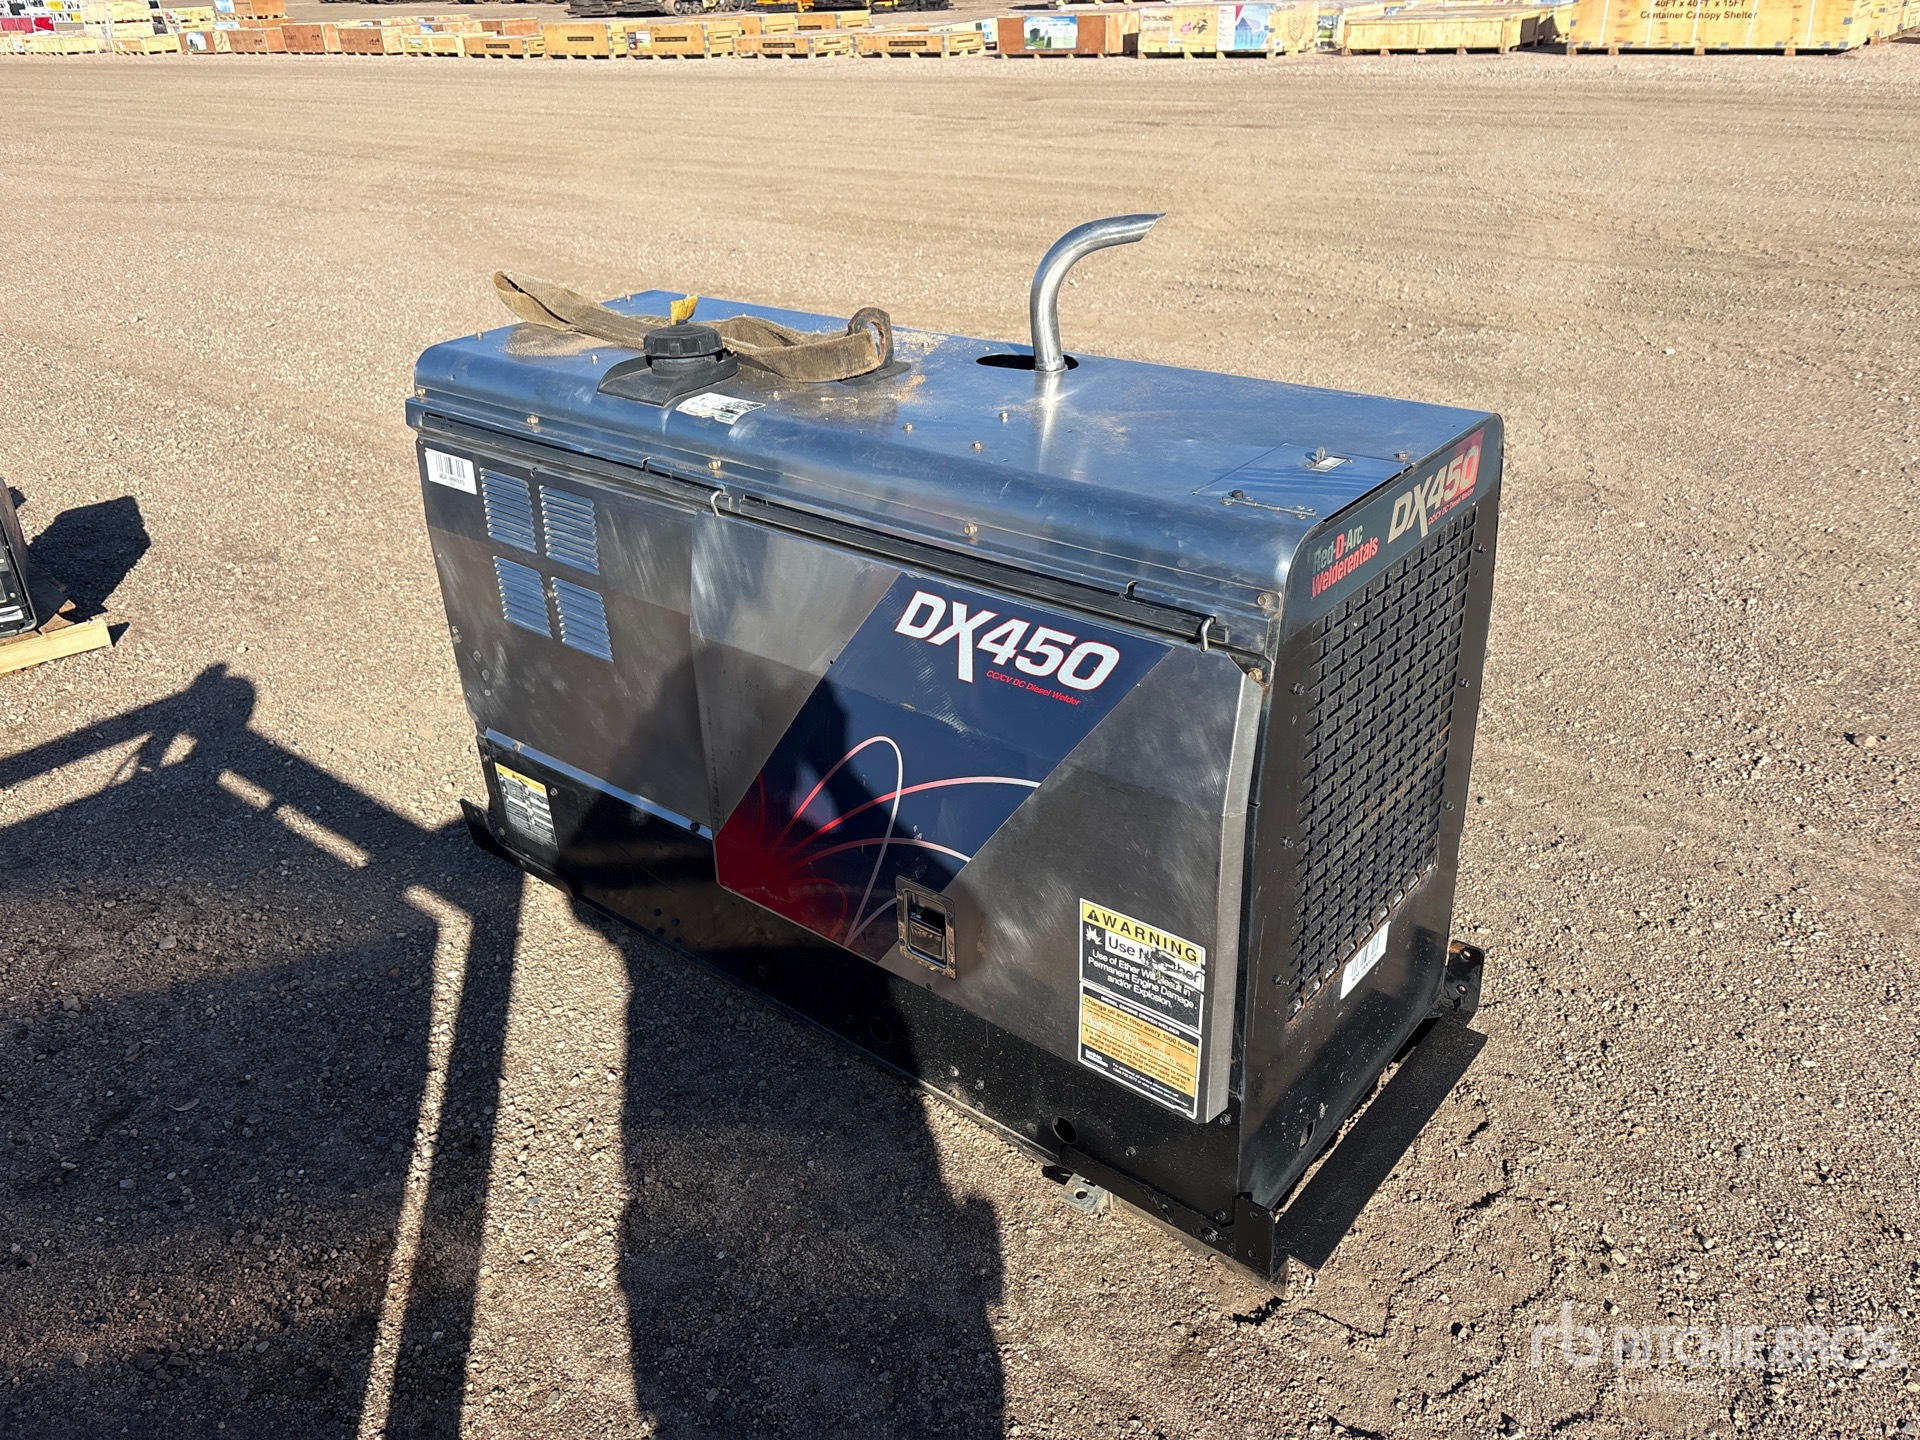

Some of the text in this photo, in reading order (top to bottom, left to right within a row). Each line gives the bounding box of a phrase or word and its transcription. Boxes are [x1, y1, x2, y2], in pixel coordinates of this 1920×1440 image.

[1640, 10, 1758, 20] Container Canopy Shelter
[1387, 444, 1480, 544] DX450
[1311, 536, 1379, 598] Welderentals
[895, 590, 1120, 691] DX450
[986, 670, 1081, 706] CC/CV DC Diesel Welder
[1102, 912, 1197, 963] WARNING
[1108, 936, 1136, 956] Use
[1088, 956, 1130, 981] Permanent
[1131, 974, 1160, 992] Engine
[1092, 949, 1108, 962] Use
[1108, 957, 1118, 966] of
[1118, 959, 1141, 975] Ether
[1107, 975, 1173, 1009] and/or Explosion.
[1084, 997, 1107, 1011] Change
[1116, 1013, 1128, 1021] and
[1144, 1026, 1161, 1038] every
